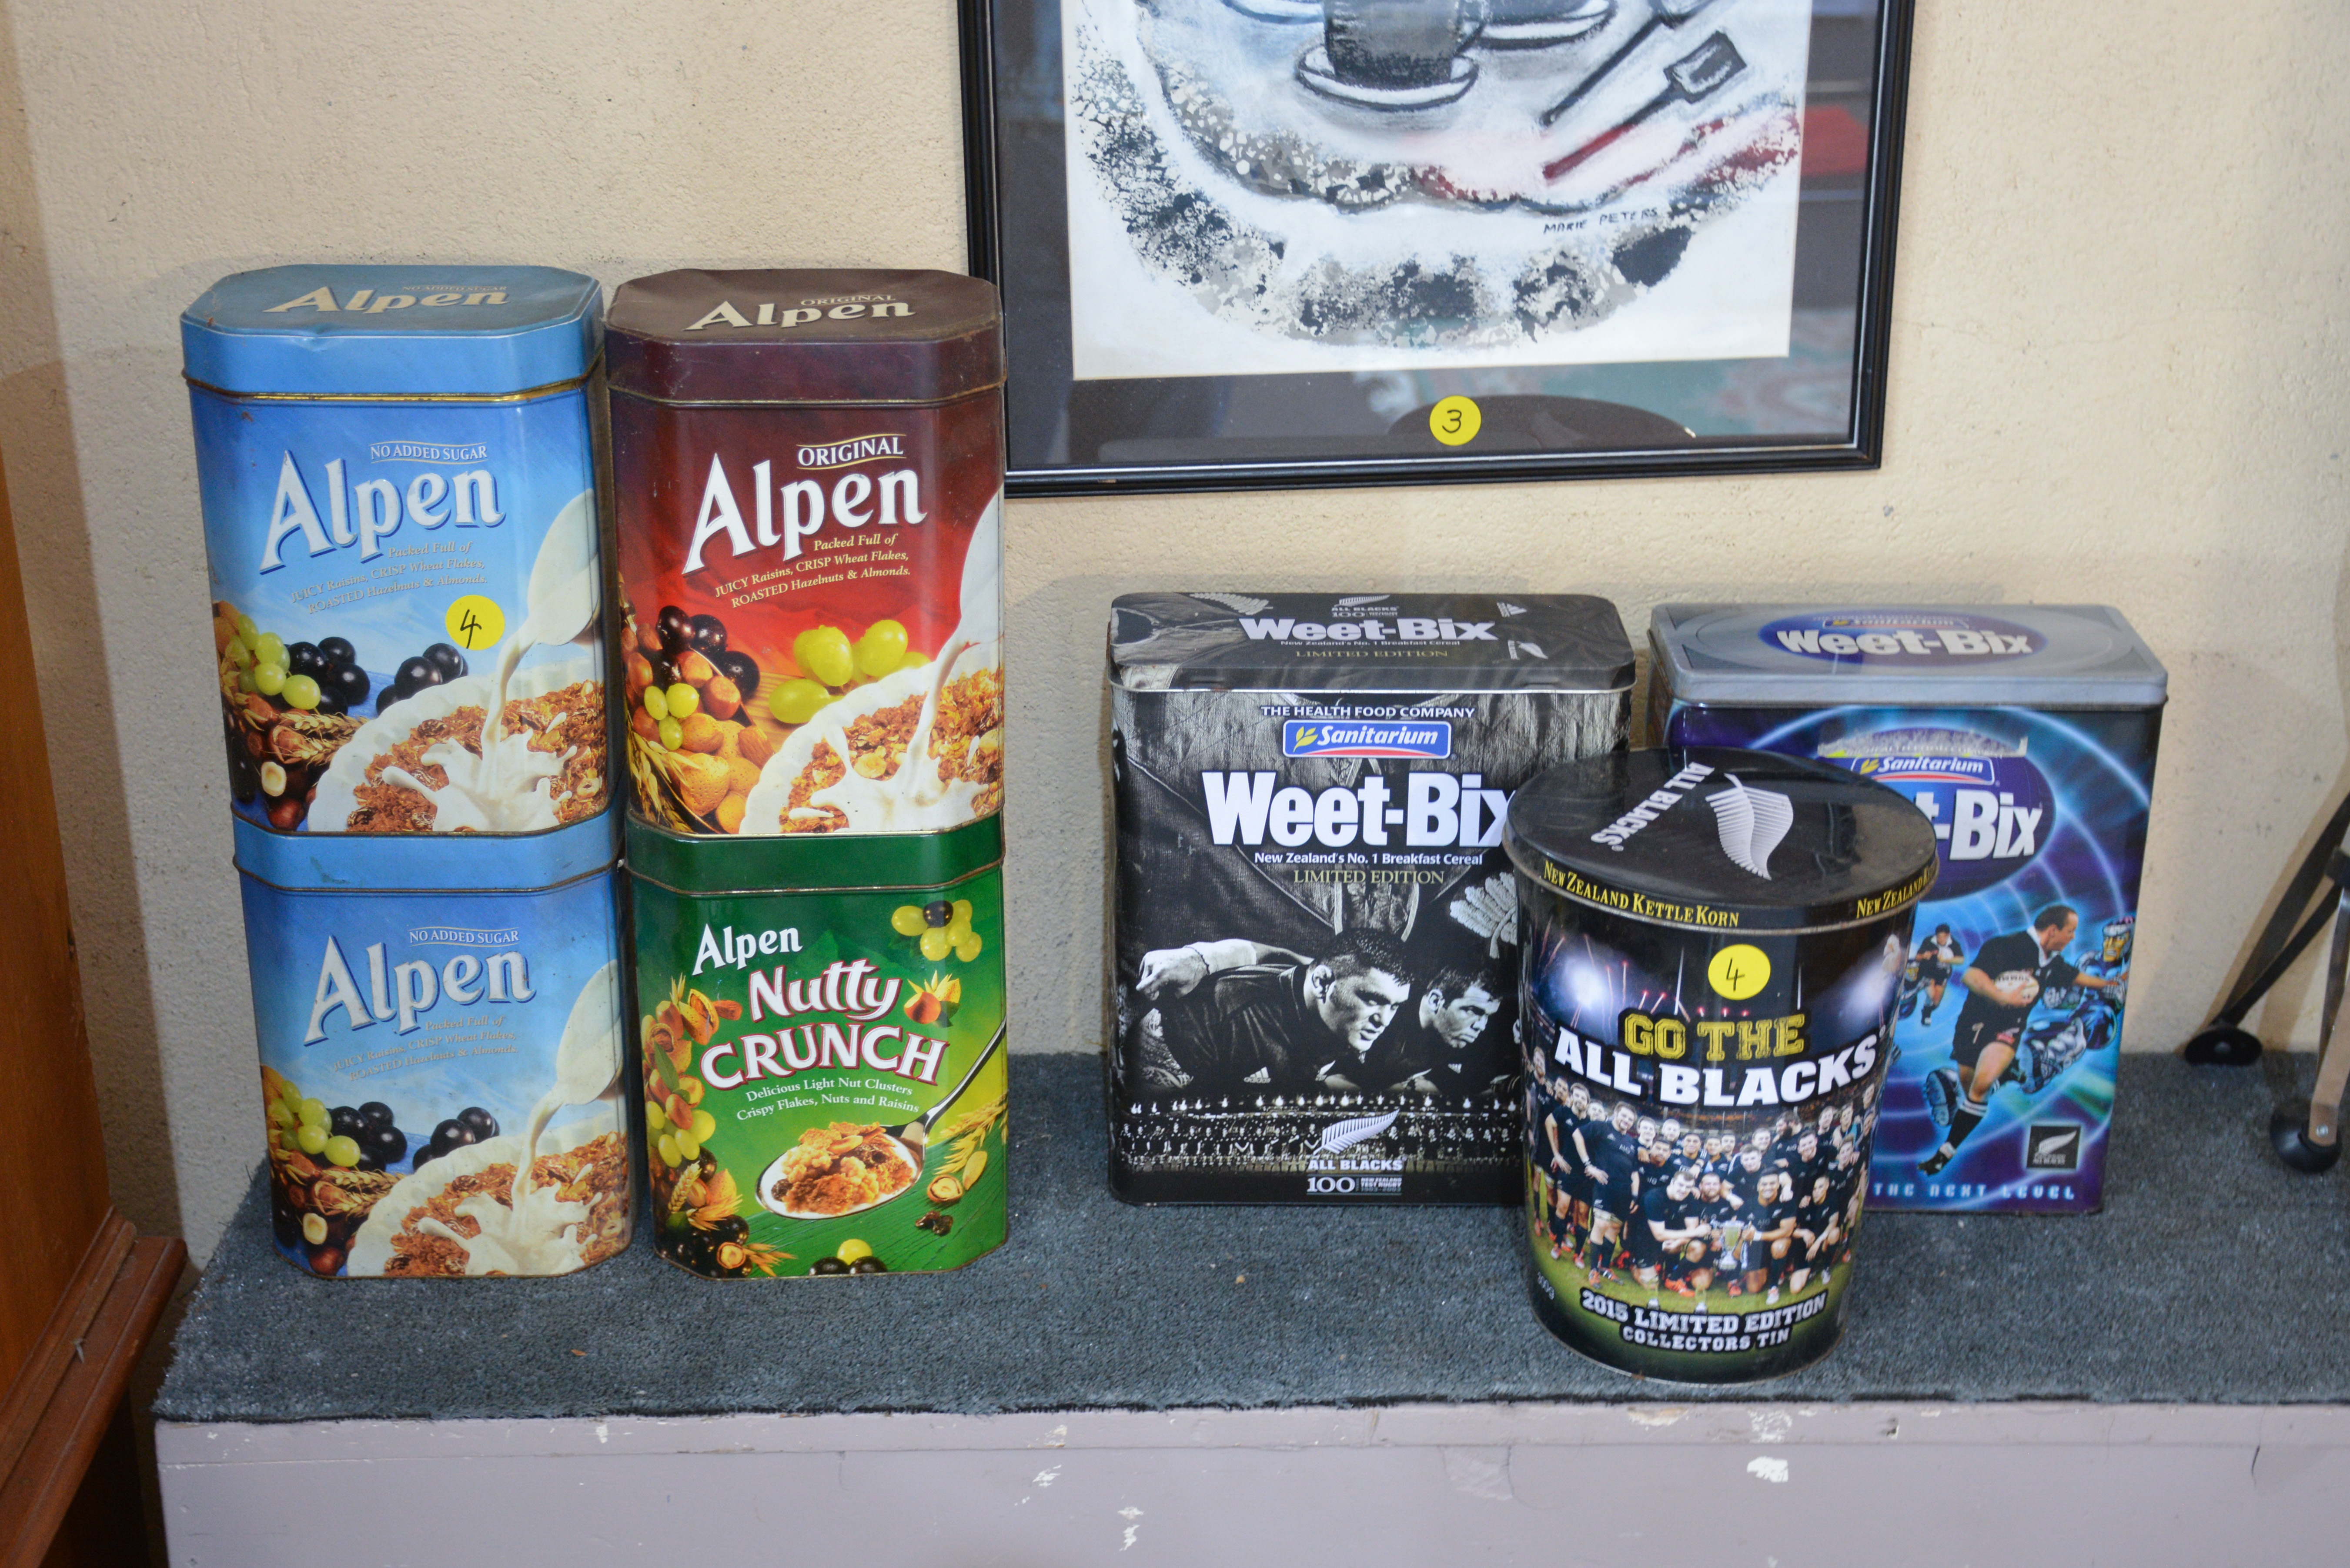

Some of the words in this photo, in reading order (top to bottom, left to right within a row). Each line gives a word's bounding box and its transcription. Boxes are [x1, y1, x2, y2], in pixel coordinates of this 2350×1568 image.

[1543, 219, 1587, 234] MARIE
[1599, 207, 1658, 226] PETERS
[263, 287, 510, 314] Alpen
[801, 295, 896, 306] ORIGINAL
[683, 300, 916, 331] Alpen
[1441, 410, 1462, 433] 3
[371, 445, 391, 459] NO
[394, 444, 440, 460] ADDED
[443, 445, 488, 460] SUGAR
[798, 437, 904, 467] ORIGINAL
[260, 450, 506, 575] Alpen
[682, 453, 928, 575] Alpen
[388, 543, 429, 558] Packed
[433, 541, 456, 554] Full
[459, 541, 474, 555] of
[814, 537, 855, 552] Packed
[858, 534, 881, 545] Full
[884, 533, 899, 547] of
[291, 583, 324, 603] JUICY
[327, 574, 369, 591] Raisins,
[371, 564, 406, 579] CRISP
[409, 561, 444, 573] Wheat
[446, 558, 485, 569] Flakes,
[715, 577, 749, 598] JUICY
[752, 568, 794, 585] Raisins,
[796, 557, 832, 572] CRISP
[834, 553, 868, 565] Wheat
[871, 550, 909, 562] Flakes,
[731, 583, 789, 608] ROASTED
[791, 573, 844, 591] Hazelnuts
[847, 569, 859, 579] &
[860, 565, 911, 578] Almonds.
[308, 590, 364, 614] ROASTED
[367, 581, 420, 597] Hazelnuts
[423, 578, 435, 587] &
[437, 573, 488, 586] Almonds.
[460, 608, 482, 649] 4
[1238, 618, 1498, 641] Weet-Bix
[1777, 629, 2033, 655] Weet-Bix
[1260, 705, 1291, 717] THE
[1294, 705, 1350, 717] HEALTH
[1354, 706, 1396, 717] FOOD
[1400, 707, 1476, 718] COMPANY
[1317, 725, 1438, 746] Sanitarium
[1664, 762, 1715, 789] ALL
[1878, 757, 1983, 773] Sanitarium
[1591, 790, 1683, 845] BLACKS
[1254, 853, 1285, 864] New
[1286, 853, 1344, 864] Zealand's
[1347, 853, 1368, 864] No.
[1372, 853, 1377, 864] 1
[1382, 853, 1441, 865] Breakfast
[1443, 854, 1483, 865] Cereal
[1294, 869, 1366, 883] LIMITED
[1371, 870, 1445, 884] EDITION
[409, 929, 428, 944] NO
[431, 929, 475, 944] ADDED
[478, 929, 519, 945] SUGAR
[692, 923, 803, 976] Alpen
[1725, 957, 1746, 993] 4
[304, 935, 536, 1047] Alpen
[748, 958, 902, 1022] Nutty
[425, 1017, 463, 1031] Packed
[467, 1015, 489, 1027] Full
[492, 1015, 505, 1027] of
[1624, 1013, 1686, 1060] GO
[1696, 1014, 1805, 1061] THE
[333, 1054, 364, 1073] JUICY
[368, 1045, 407, 1060] Raisins,
[408, 1036, 443, 1050] CRISP
[445, 1033, 478, 1044] Wheat
[480, 1030, 517, 1041] Flakes,
[349, 1060, 403, 1081] ROASTED
[405, 1052, 455, 1067] Hazelnuts
[457, 1048, 468, 1057] &
[471, 1044, 518, 1056] Almonds.
[699, 1023, 949, 1091] CRUNCH
[1554, 1026, 1642, 1096] ALL
[1658, 1034, 1877, 1107] BLACKS
[745, 1079, 800, 1103] Delicious
[803, 1076, 835, 1093] Light
[838, 1076, 862, 1089] Nut
[864, 1078, 913, 1097] Clusters
[736, 1104, 775, 1122] Crispy
[777, 1094, 819, 1110] Flakes,
[821, 1093, 850, 1105] Nuts
[853, 1093, 875, 1106] and
[878, 1095, 919, 1114] Raisins
[1307, 1160, 1336, 1170] ALL
[1340, 1159, 1403, 1171] BLACKS
[1307, 1177, 1356, 1193] 100
[1873, 1183, 1914, 1197] THE
[1929, 1184, 1986, 1198] NEXT
[2001, 1185, 2075, 1200] LEVEL
[1582, 1289, 1628, 1322] 2015
[1634, 1307, 1739, 1334] LIMITED
[1744, 1292, 1827, 1334] EDITION
[1623, 1326, 1751, 1352] COLLECTORS
[1756, 1327, 1790, 1347] TIN
